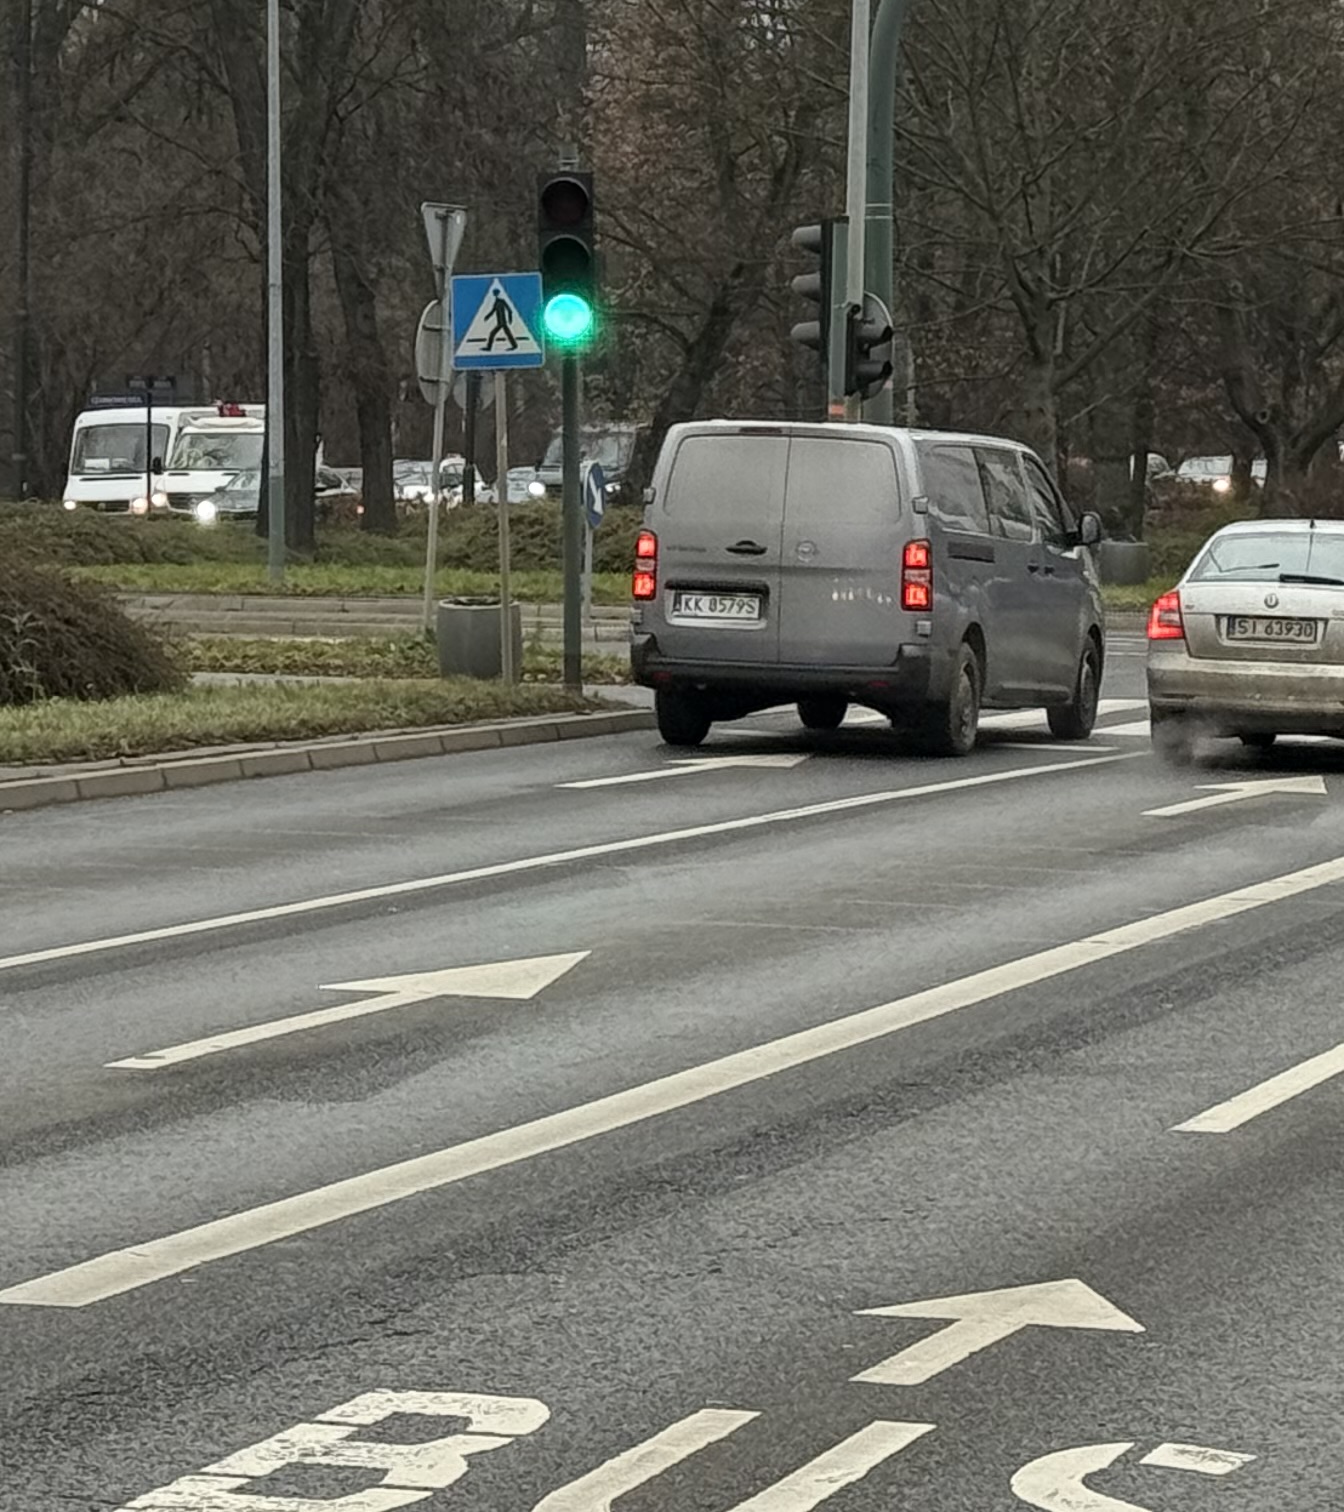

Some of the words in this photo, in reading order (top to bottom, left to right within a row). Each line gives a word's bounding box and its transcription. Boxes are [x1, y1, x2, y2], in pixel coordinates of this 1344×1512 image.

[683, 597, 704, 613] KK
[1237, 619, 1256, 635] SI
[1263, 620, 1314, 638] 63930
